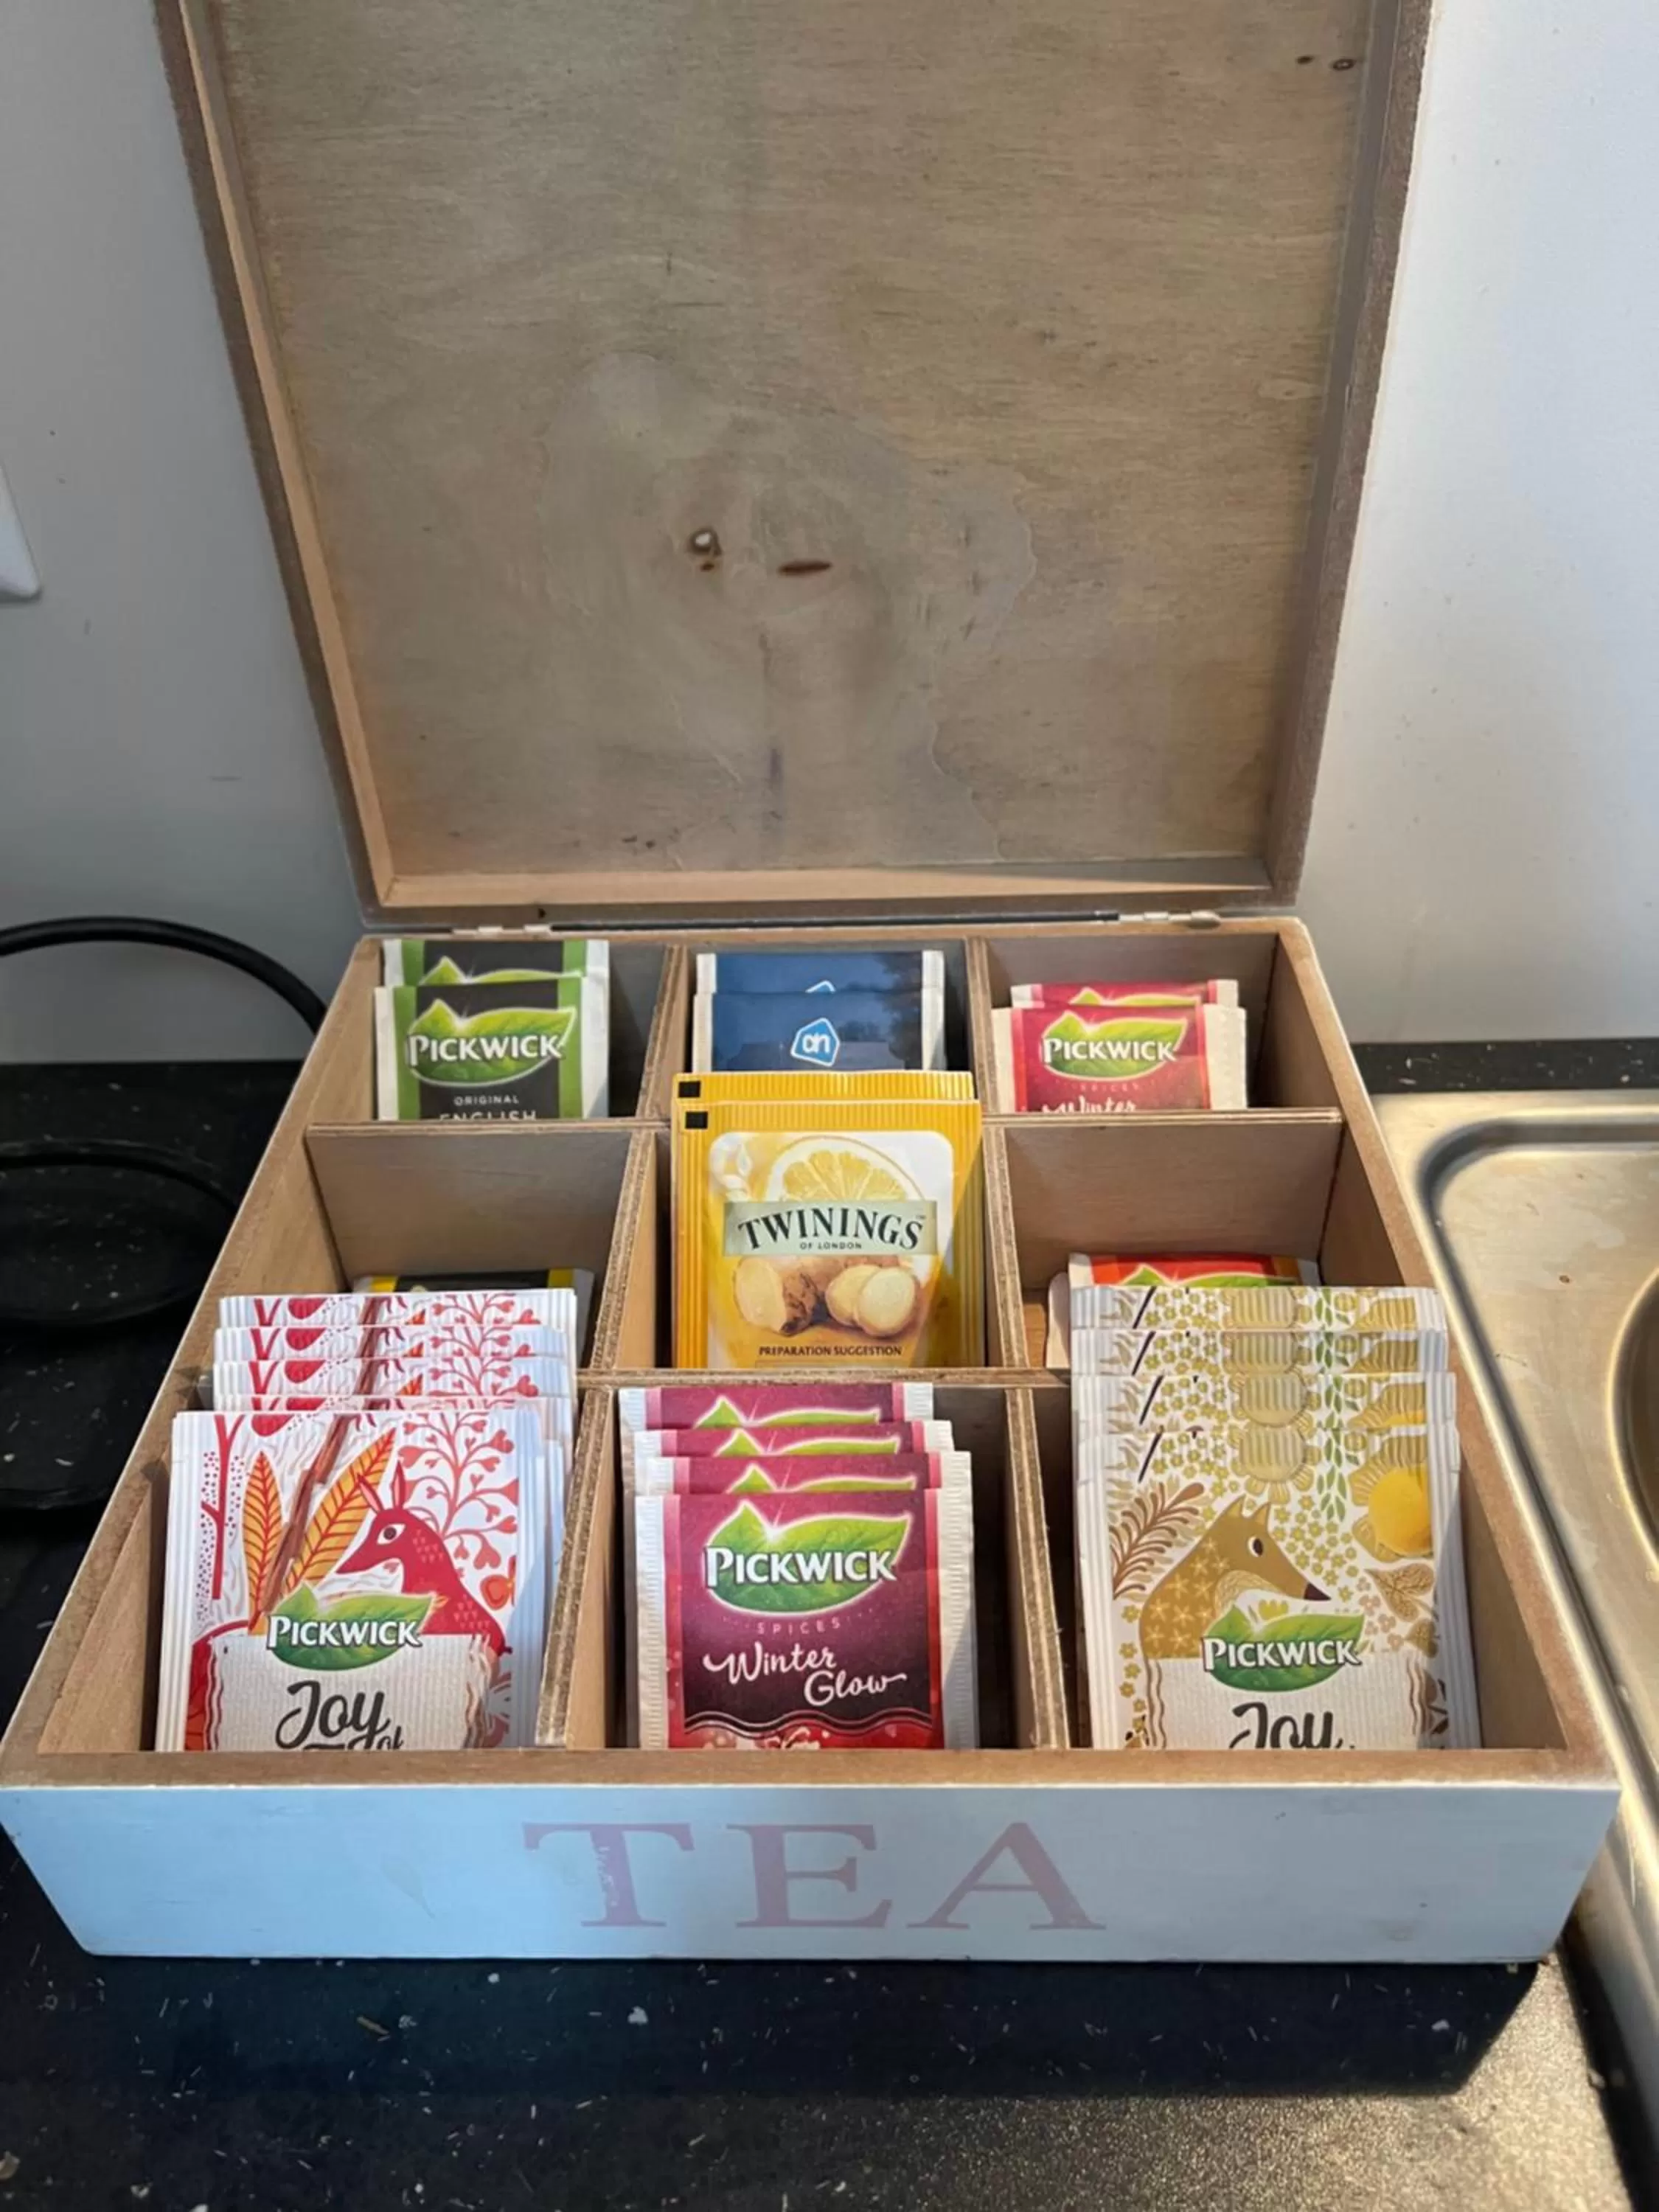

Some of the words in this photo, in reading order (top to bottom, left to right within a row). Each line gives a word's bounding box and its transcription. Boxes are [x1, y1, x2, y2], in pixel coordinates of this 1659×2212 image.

[408, 1034, 562, 1067] PICKWICK
[1043, 1038, 1177, 1064] PICKWICK
[453, 1094, 520, 1106] ORIGINAL
[737, 1207, 923, 1251] TWININGS
[799, 1242, 813, 1250] OF
[818, 1241, 862, 1250] LONDON
[759, 1346, 831, 1356] PREPARATION
[833, 1346, 902, 1356] SUGGESTION
[704, 1547, 897, 1587] PICKWICK
[266, 1615, 422, 1649] PICKWICK
[757, 1617, 841, 1635] SPICES
[703, 1641, 838, 1685] Winter
[1203, 1636, 1363, 1671] PICKWICK
[803, 1669, 908, 1706] Glow
[275, 1679, 392, 1750] Joy
[522, 1822, 1107, 1930] TEA
